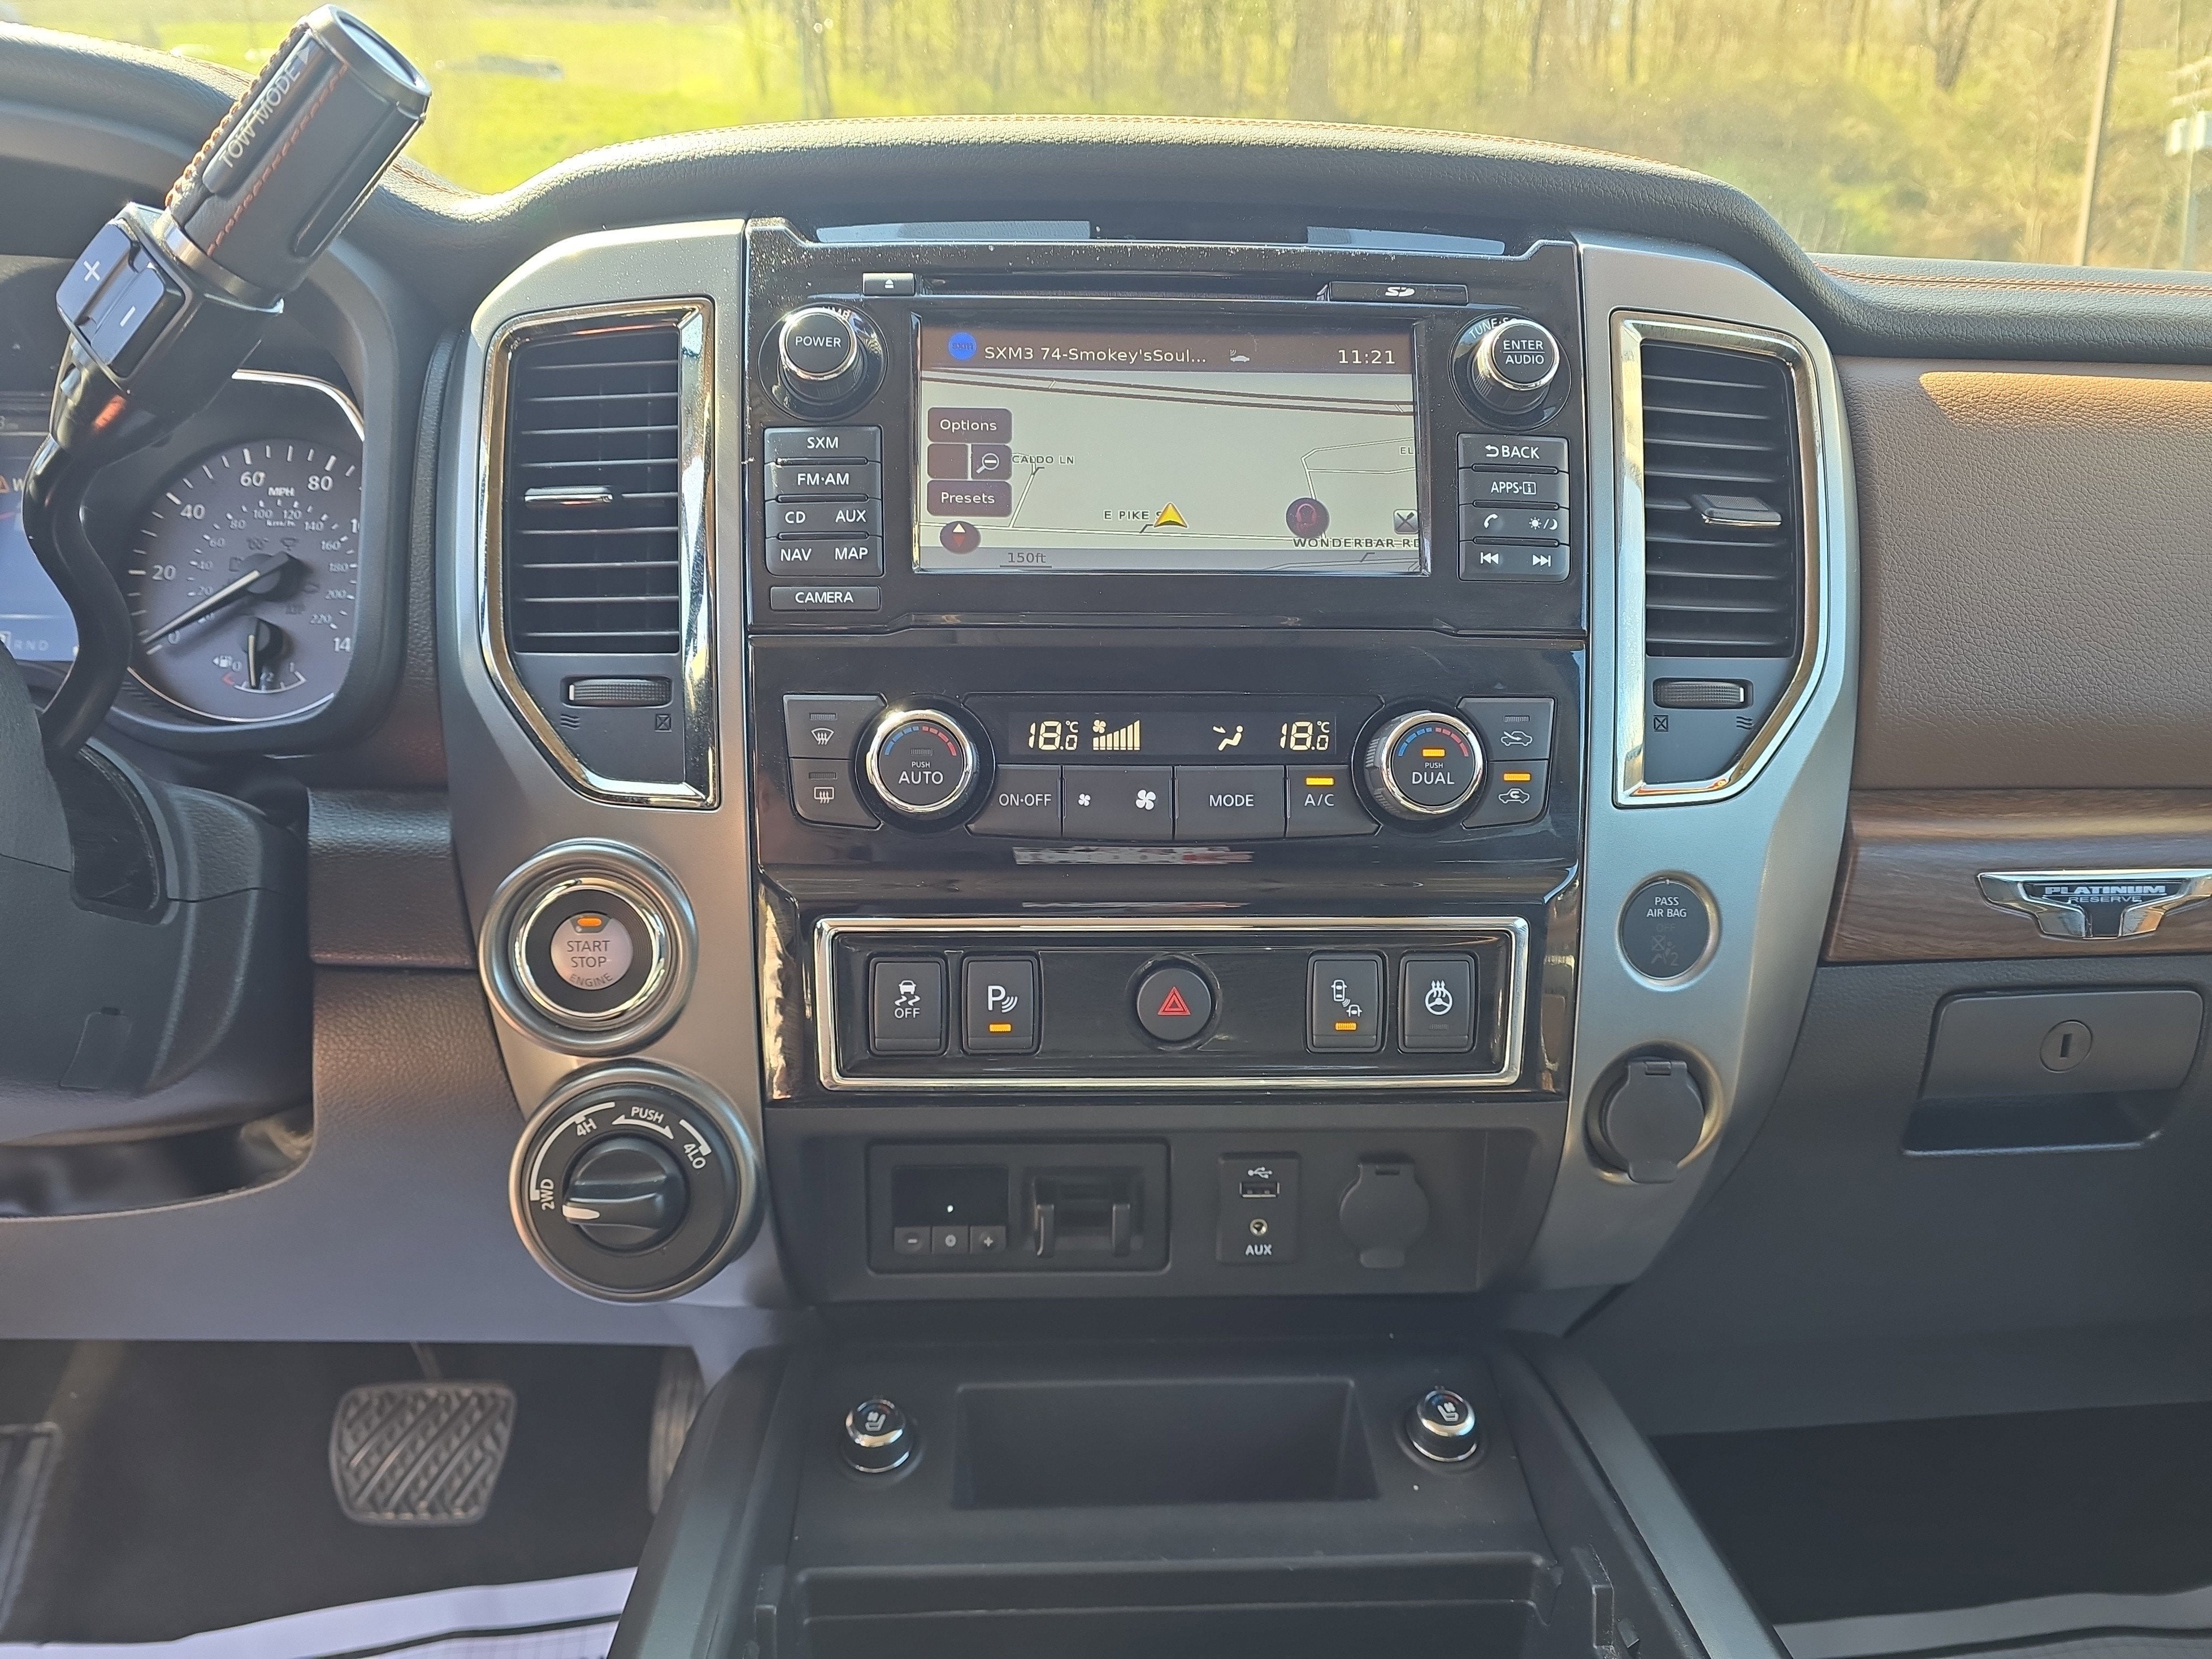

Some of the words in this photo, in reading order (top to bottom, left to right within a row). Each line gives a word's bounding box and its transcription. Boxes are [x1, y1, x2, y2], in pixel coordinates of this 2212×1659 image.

[218, 120, 255, 168] TOW
[253, 61, 300, 125] MODE
[795, 336, 841, 348] POWER
[1503, 340, 1544, 350] ENTER
[985, 346, 1033, 359] SXM3
[1338, 349, 1395, 365] 11:21
[1505, 355, 1544, 365] AUDIO
[940, 419, 997, 433] Options
[807, 436, 838, 449] SXM
[1502, 445, 1540, 459] BACK
[1012, 455, 1053, 464] CALDO
[1060, 456, 1074, 464] LN
[240, 471, 266, 487] 60
[307, 475, 333, 491] 80
[268, 487, 295, 497] MPH
[941, 492, 995, 504] Presets
[180, 504, 205, 519] 40
[254, 510, 273, 519] 100
[284, 510, 301, 519] 120
[785, 512, 806, 524] CD
[835, 511, 866, 523] AUX
[1104, 511, 1111, 519] E
[1120, 511, 1149, 519] PIKE
[229, 519, 246, 530] 80
[304, 522, 324, 531] 140
[209, 538, 226, 548] 60
[321, 541, 342, 551] 160
[1294, 538, 1394, 548] WONDERBAR
[780, 548, 812, 562] NAV
[834, 548, 868, 560] MAP
[1007, 552, 1046, 563] 150ft
[152, 564, 176, 581] 20
[795, 591, 853, 604] CAMERA
[898, 770, 943, 785] AUTO
[1412, 771, 1455, 786] DUAL
[1209, 794, 1254, 807] MODE
[1304, 794, 1334, 807] A/C
[2045, 886, 2165, 894] PLATINUM
[1655, 897, 1679, 905] PASS
[1646, 909, 1663, 917] AIR
[1667, 909, 1687, 917] BAG
[567, 940, 610, 952] START
[571, 956, 607, 968] STOP
[570, 973, 612, 987] ENGINE
[895, 1008, 919, 1019] OFF
[631, 1107, 664, 1123] PUSH
[576, 1118, 596, 1136] 4H
[684, 1143, 706, 1169] 4LO
[540, 1179, 555, 1211] 2WD
[1245, 1244, 1272, 1256] AUX
